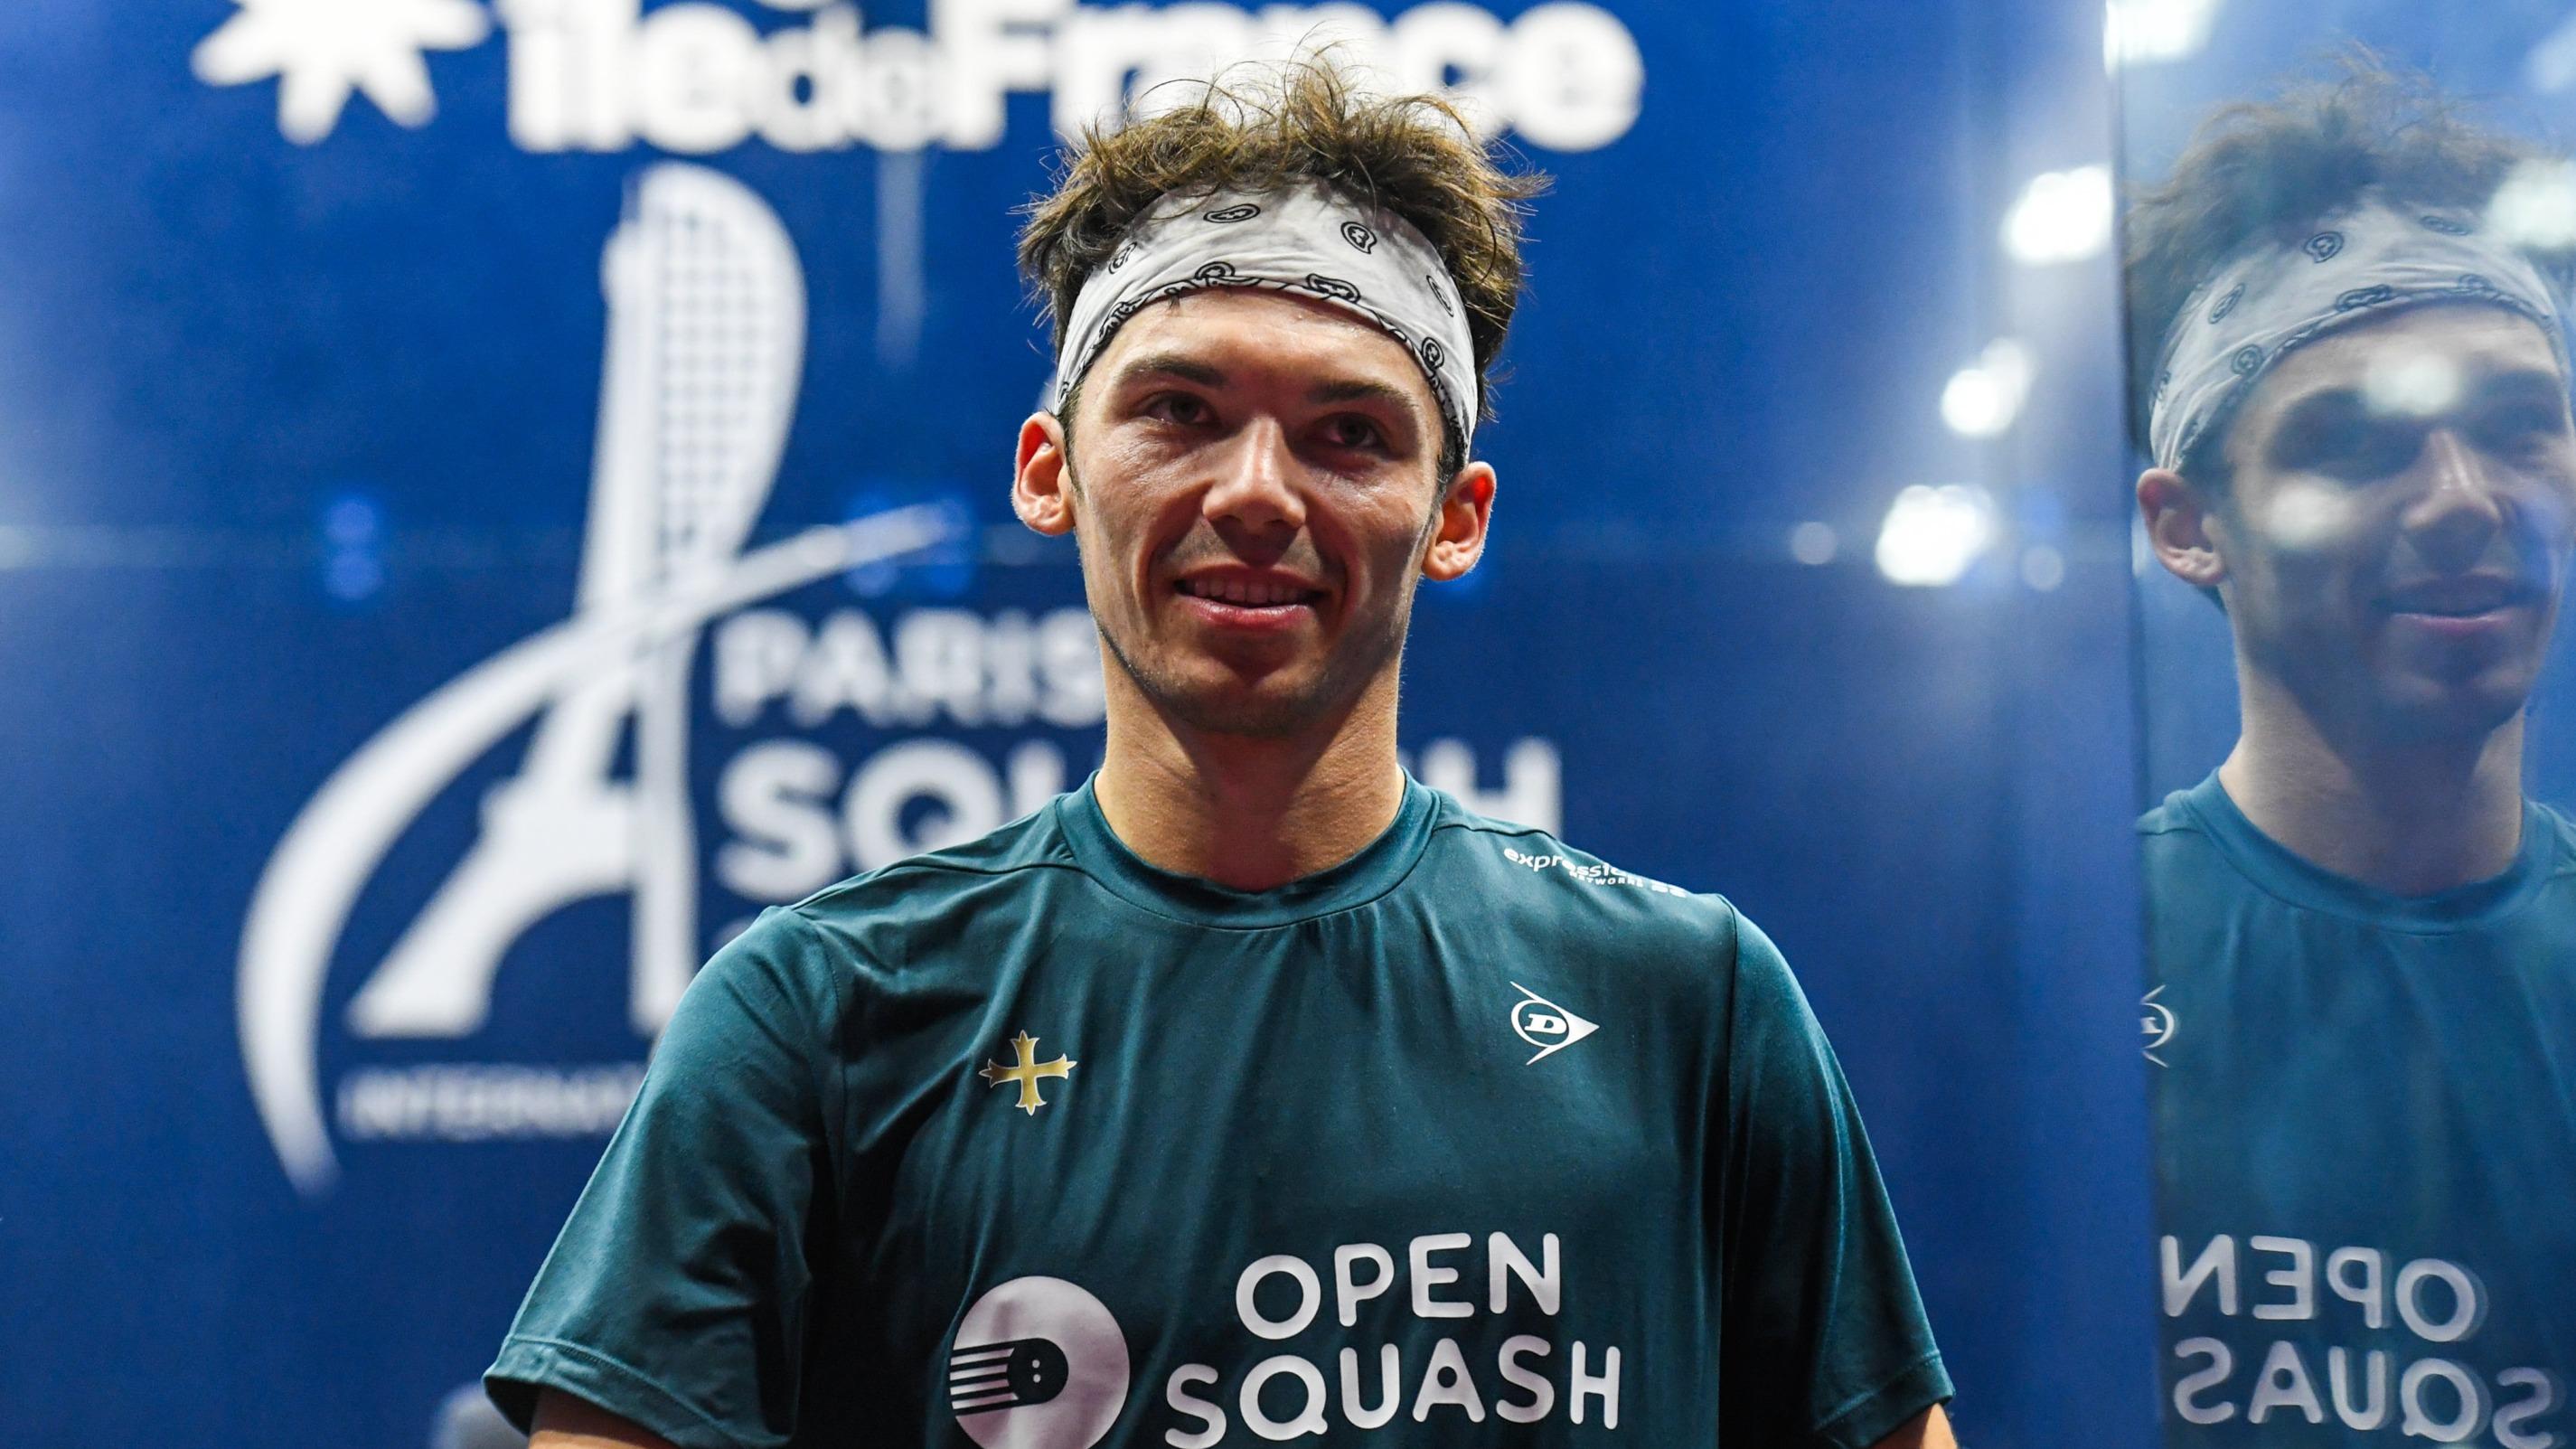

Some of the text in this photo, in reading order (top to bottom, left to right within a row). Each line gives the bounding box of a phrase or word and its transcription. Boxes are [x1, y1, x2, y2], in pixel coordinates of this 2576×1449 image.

[712, 607, 1105, 726] PARIS
[718, 738, 1562, 902] SQH
[1503, 848, 1645, 881] expressio
[1236, 1231, 1560, 1340] OPEN
[1165, 1334, 1621, 1449] SQUASH
